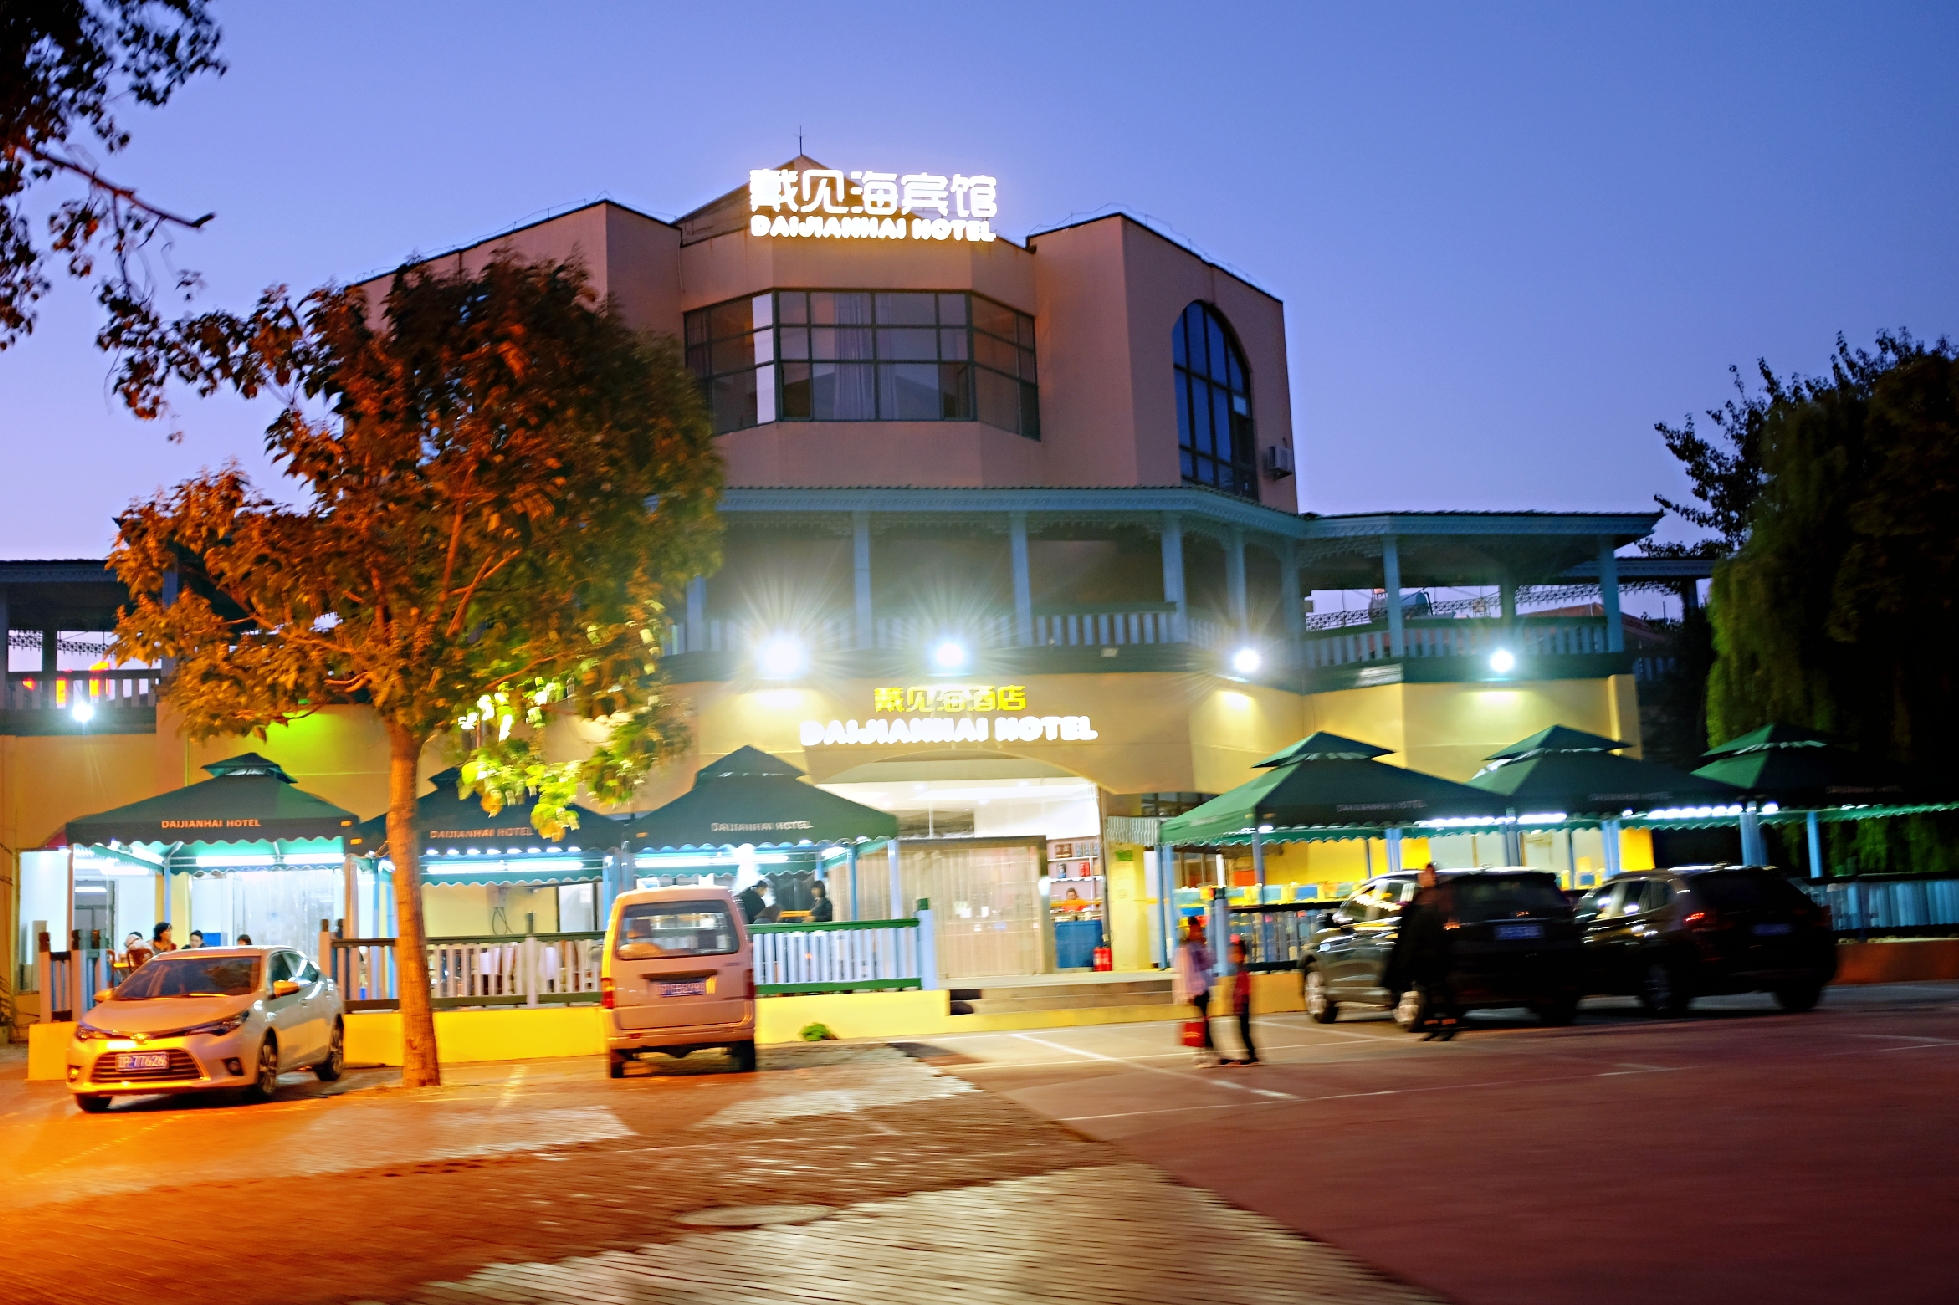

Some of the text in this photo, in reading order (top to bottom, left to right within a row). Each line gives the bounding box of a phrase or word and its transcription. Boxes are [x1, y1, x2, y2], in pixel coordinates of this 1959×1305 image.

[750, 169, 997, 217] 戴见海宾馆
[912, 219, 996, 241] HOTEL
[874, 684, 1027, 713] 戴见海酒店
[994, 716, 1098, 742] HOTEL
[161, 819, 262, 828] DAIJIANHAI HOTEL
[497, 827, 534, 837] HOTEL
